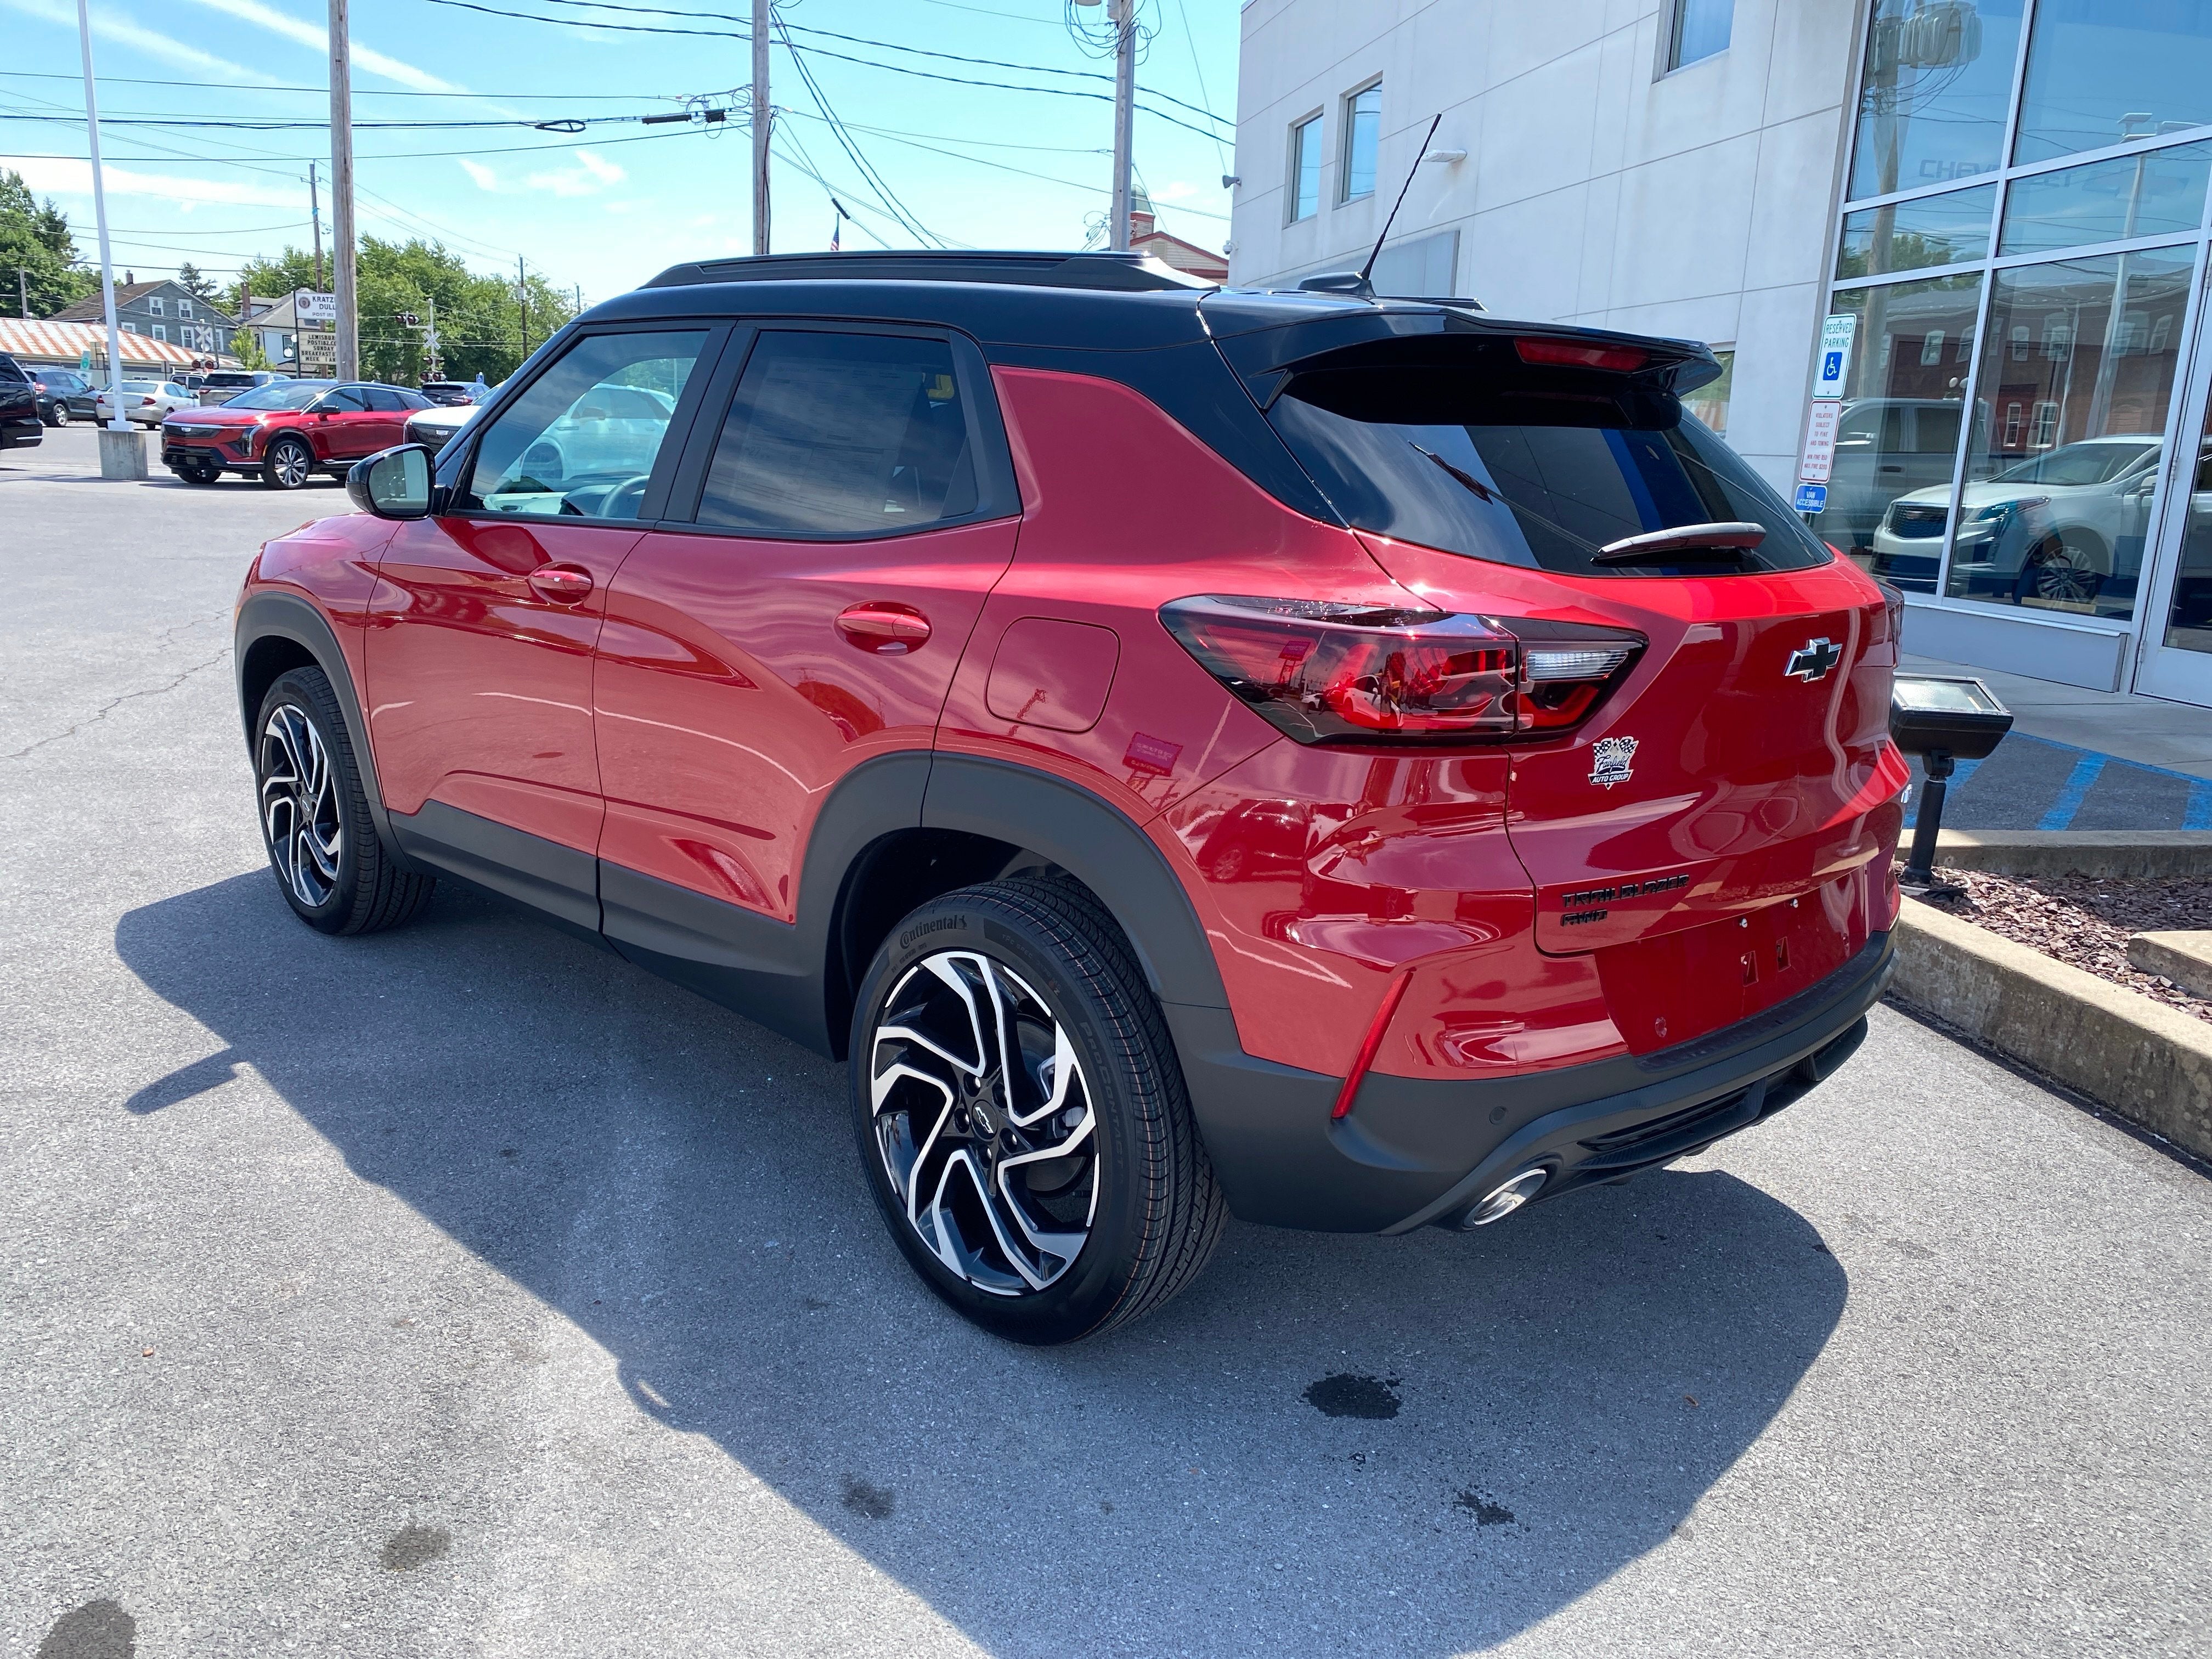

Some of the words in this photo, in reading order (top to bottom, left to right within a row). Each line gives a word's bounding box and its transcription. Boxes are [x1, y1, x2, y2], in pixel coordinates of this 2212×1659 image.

[1825, 323, 1852, 334] RESERVED
[1824, 337, 1849, 348] PARKING
[1797, 498, 1824, 507] ACCESSIBLE
[1596, 754, 1630, 774] Fairfield
[1609, 773, 1629, 781] GROUP
[1562, 874, 1690, 907] TRAILBLAZER
[1560, 909, 1607, 927] AWD
[900, 915, 958, 949] Continental
